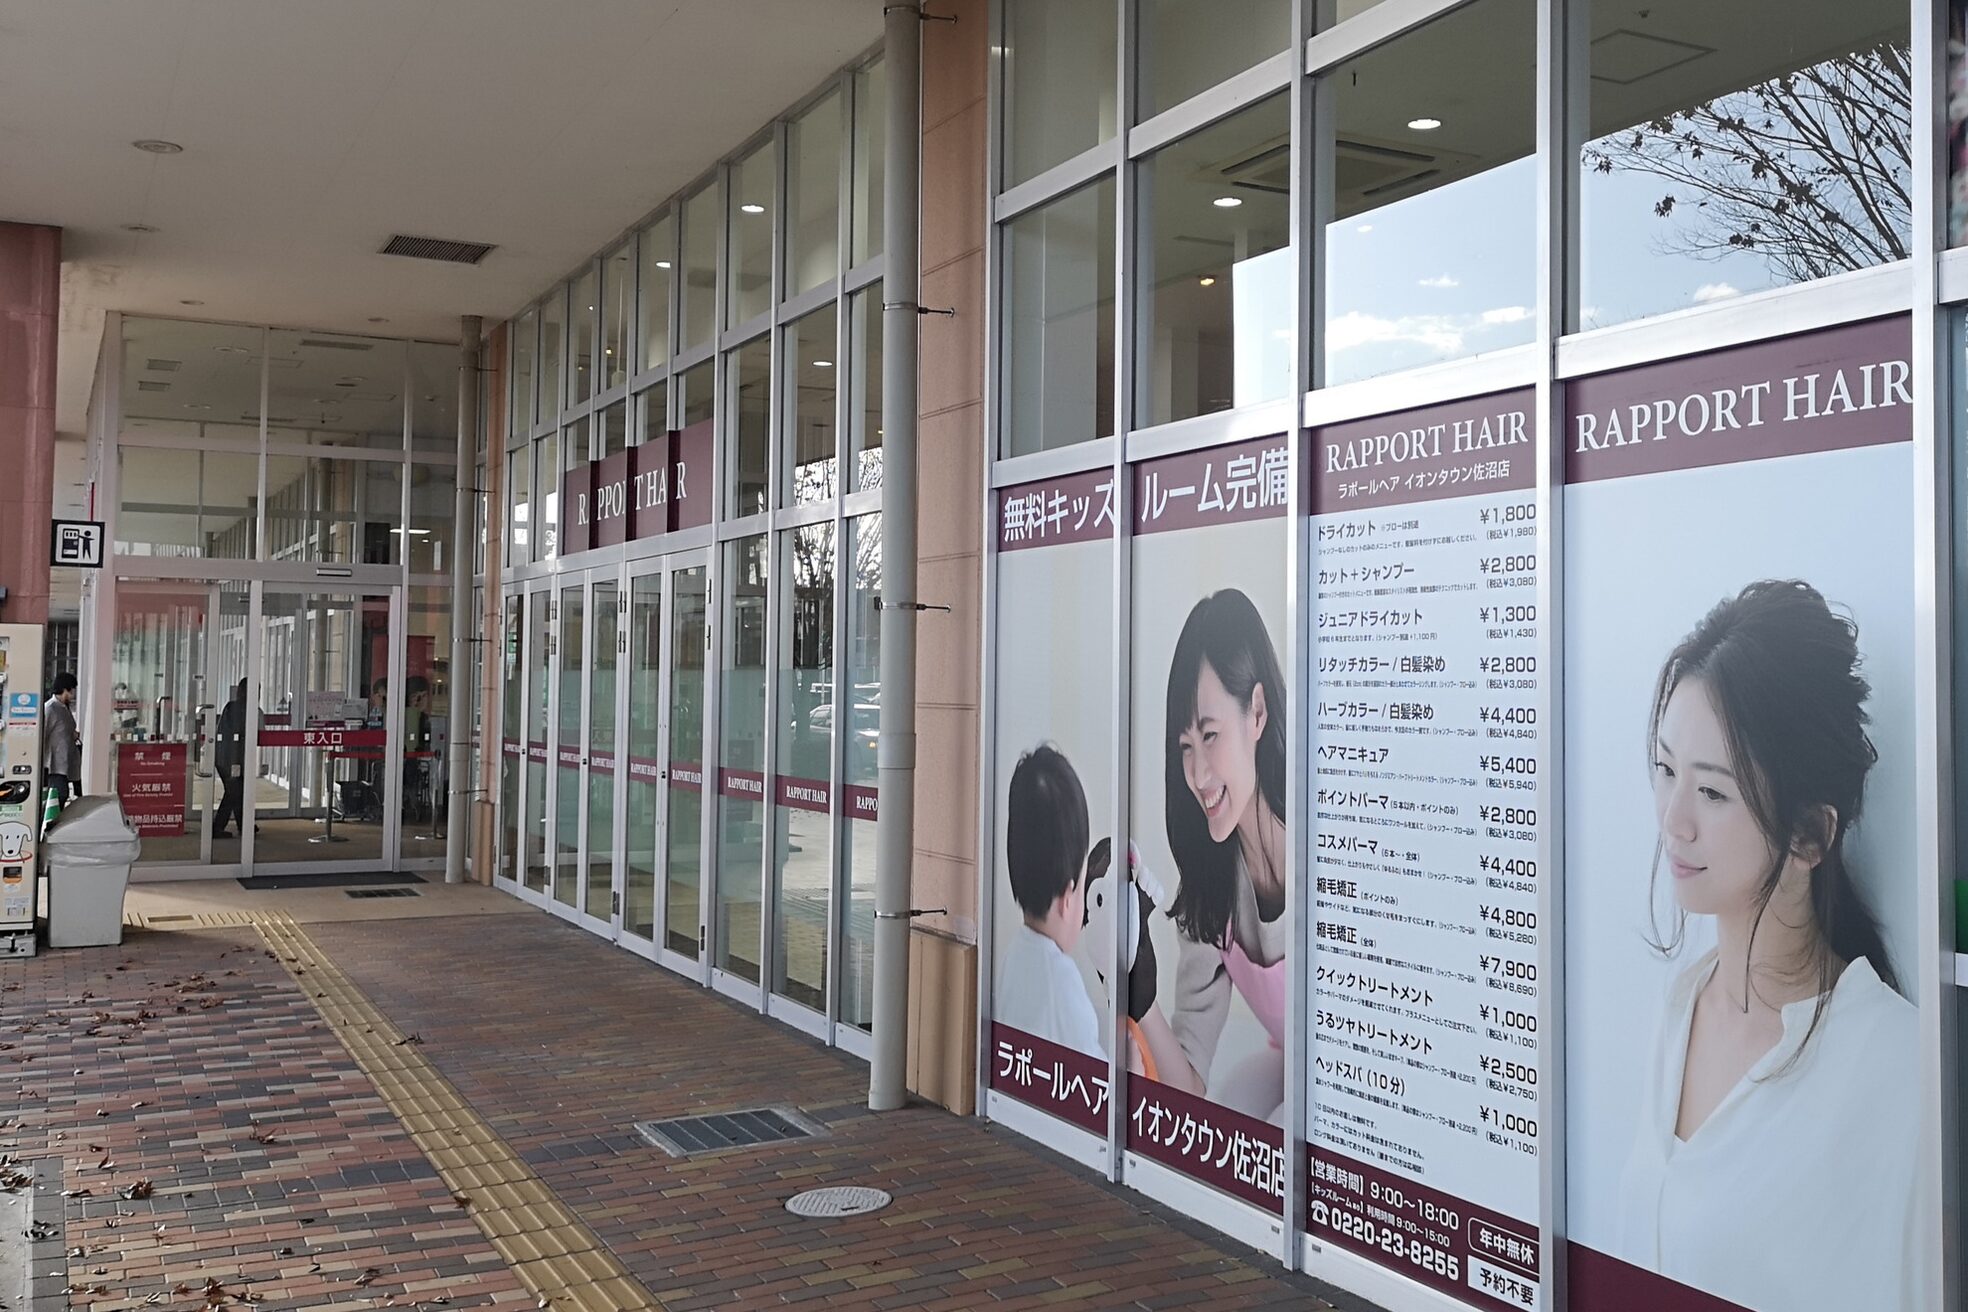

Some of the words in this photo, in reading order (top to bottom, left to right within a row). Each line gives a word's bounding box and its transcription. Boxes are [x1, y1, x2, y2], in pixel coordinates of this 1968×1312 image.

[1575, 380, 1771, 453] RAPPORT
[1782, 360, 1913, 422] HAIR
[1326, 424, 1445, 473] RAPPORT
[1452, 410, 1528, 453] HAIR
[1141, 446, 1288, 523] ルーム完備
[1338, 475, 1400, 499] ラポールヘア
[1405, 460, 1510, 489] イオンタウン佐沼店
[578, 473, 644, 525] RPPOT
[646, 461, 687, 508] HAR
[1480, 504, 1537, 524] ¥1,800
[1318, 520, 1376, 541] ドライカット
[1486, 527, 1537, 540] (税込¥1,980)
[1318, 562, 1414, 585] カット+シャンプー
[1480, 555, 1537, 574] ¥2,800
[1486, 577, 1537, 589] (税込¥3,080)
[1318, 608, 1423, 628] ジュニアドライカット
[1480, 605, 1537, 623] ¥1,300
[1486, 629, 1537, 640] (税込¥1,430)
[1480, 657, 1537, 673] ¥2,800
[1486, 680, 1537, 690] (税込¥3,080)
[1480, 707, 1537, 725] ¥4,400
[303, 732, 343, 745] 東入口
[1486, 729, 1537, 739] (税込¥4,840)
[1317, 745, 1389, 764] ヘアマニキュア
[1480, 756, 1537, 774] ¥5,400
[728, 776, 750, 792] RAPPORT
[749, 780, 763, 793] HAIR
[786, 785, 812, 801] RAPPORT
[812, 789, 827, 804] HAIR
[1486, 778, 1537, 791] (税込¥5,940)
[1317, 789, 1389, 809] ポイントパーマ
[1480, 805, 1537, 826] ¥2,800
[1317, 833, 1378, 854] コスメパーマ
[1486, 828, 1537, 842] (税込¥3,080)
[1480, 855, 1537, 878] ¥4,400
[1316, 876, 1357, 899] 縮毛矯正
[1361, 892, 1398, 906] (ポイントのみ)
[1486, 878, 1537, 893] (税込¥4,840)
[1480, 905, 1537, 929] ¥4,800
[1316, 921, 1357, 944] 縮毛矯正
[1486, 927, 1537, 945] (税込¥5,280)
[1480, 955, 1537, 981] ¥7,900
[1316, 965, 1433, 1007] クイックトリートメント
[1486, 977, 1537, 997] (税込¥8,690)
[1480, 1004, 1537, 1032] ¥1,000
[1316, 1010, 1432, 1055] うるツヤトリートメント
[1486, 1028, 1537, 1049] (税込¥1,100)
[1480, 1055, 1537, 1085] ¥2,500
[1486, 1079, 1537, 1101] (税込¥2,750)
[998, 1041, 1109, 1116] ラポールヘア
[1132, 1096, 1285, 1198] イオンタウン佐沼店
[1480, 1105, 1537, 1138] ¥1,000
[1486, 1131, 1537, 1156] (税込¥1,100)
[1311, 1156, 1364, 1196] 【営業時間】
[1370, 1181, 1459, 1230] 9:00〜18:00
[1332, 1206, 1459, 1281] 0220-23-8255
[1479, 1227, 1535, 1266] 年中無休
[1479, 1266, 1534, 1307] 予約不要
